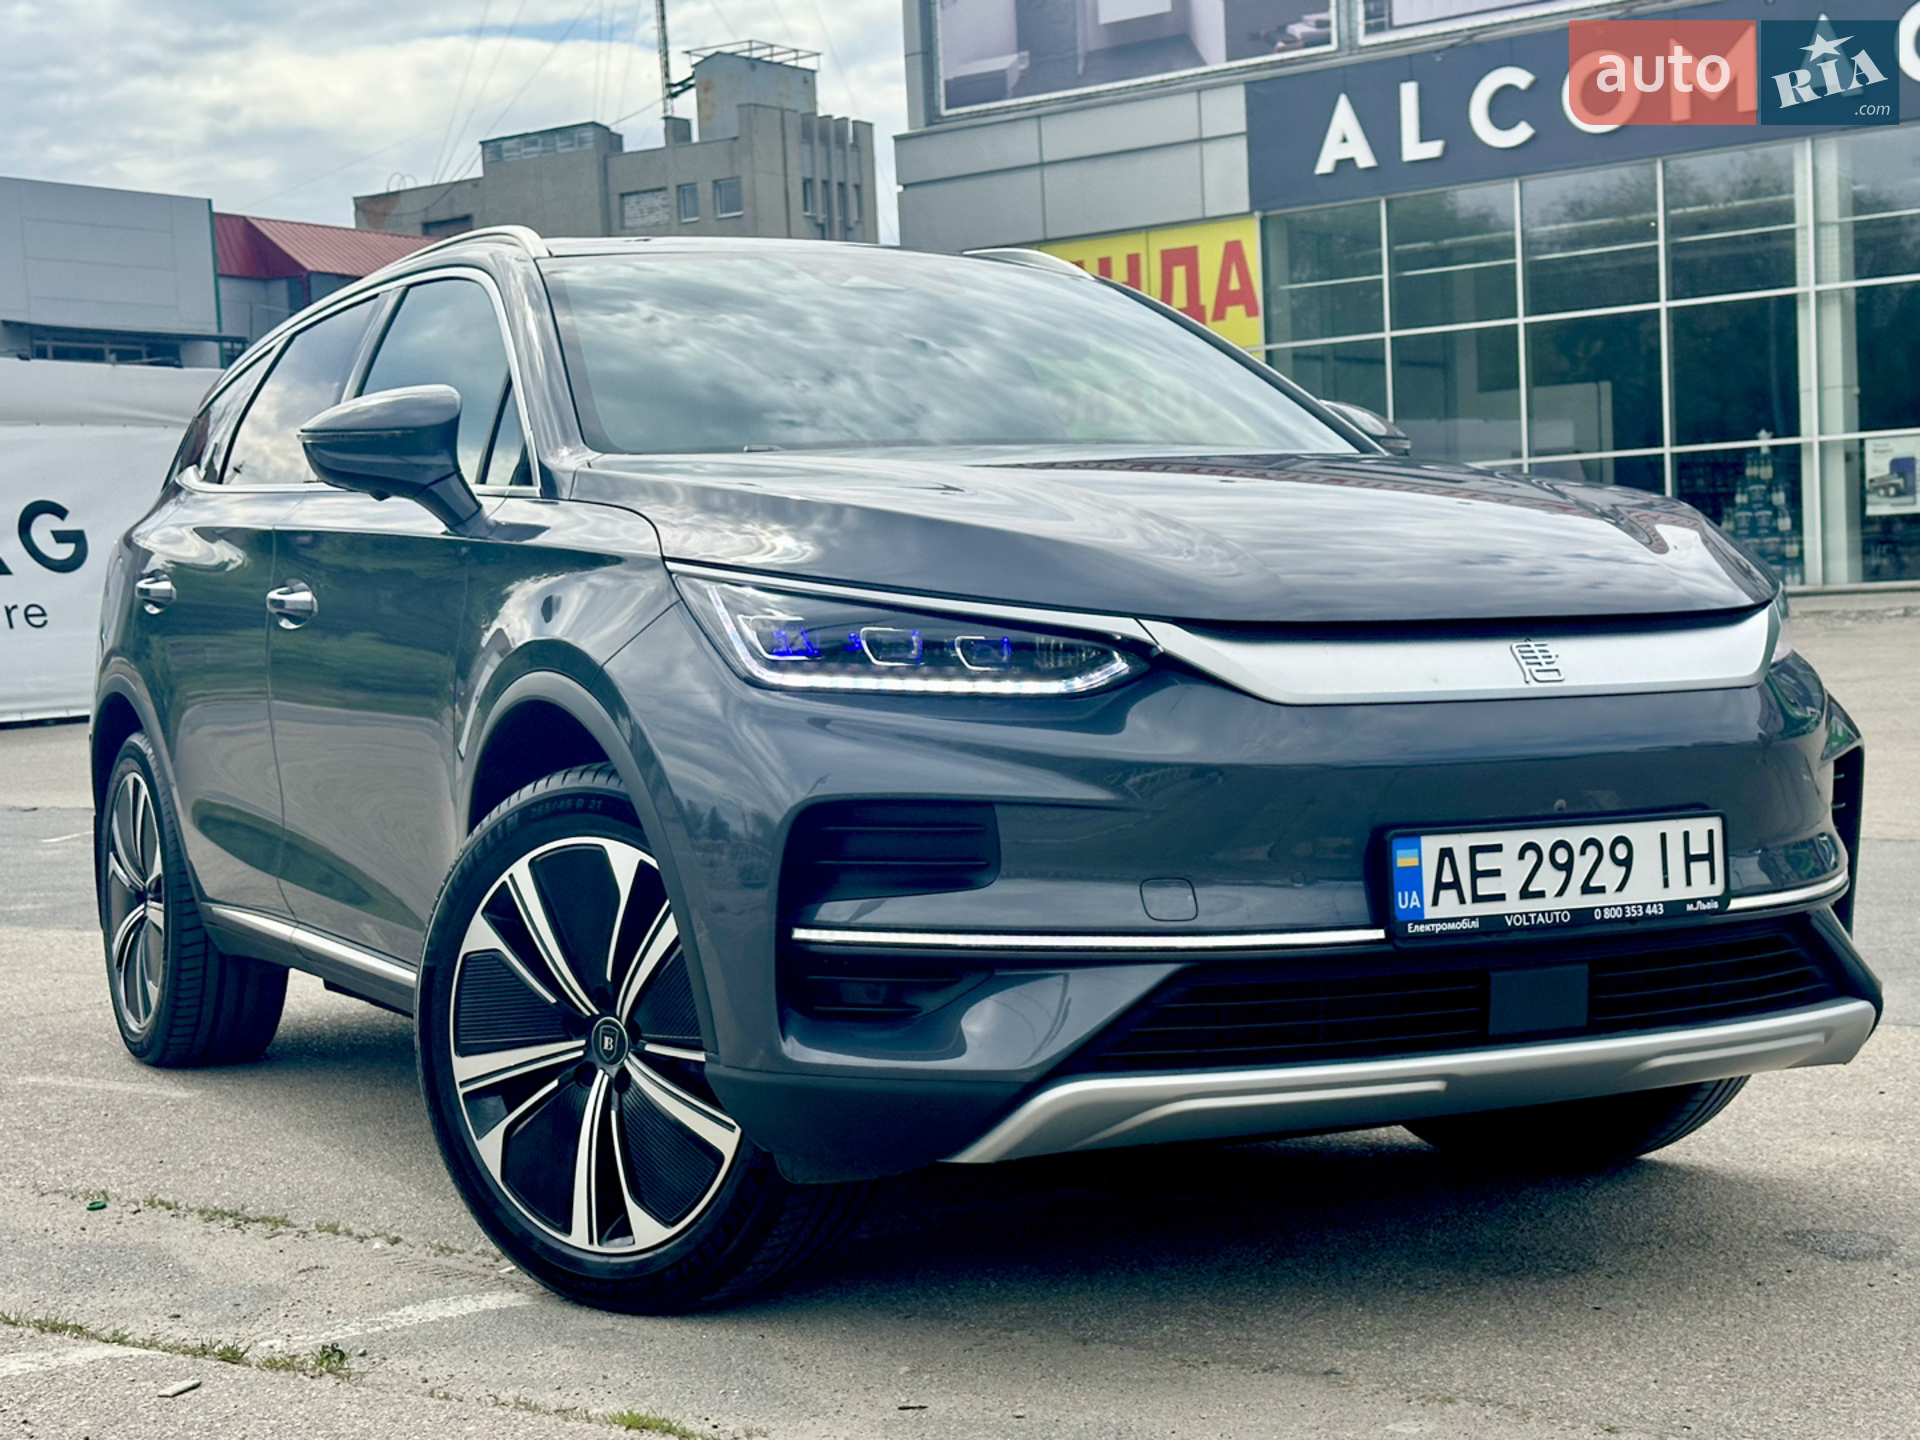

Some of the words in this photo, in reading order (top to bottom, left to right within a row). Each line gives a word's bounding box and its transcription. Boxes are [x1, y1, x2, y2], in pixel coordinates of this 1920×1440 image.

[0, 499, 89, 574] G
[1431, 843, 1507, 908] AE
[1517, 835, 1634, 901] 2929
[1659, 828, 1717, 889] IH
[1397, 890, 1421, 910] UA
[1504, 910, 1571, 927] VOLTAUTO
[1594, 908, 1602, 920] 0
[1603, 906, 1623, 919] 800
[1624, 905, 1644, 918] 353
[1645, 903, 1665, 916] 443
[1407, 917, 1480, 934] Електромобілі
